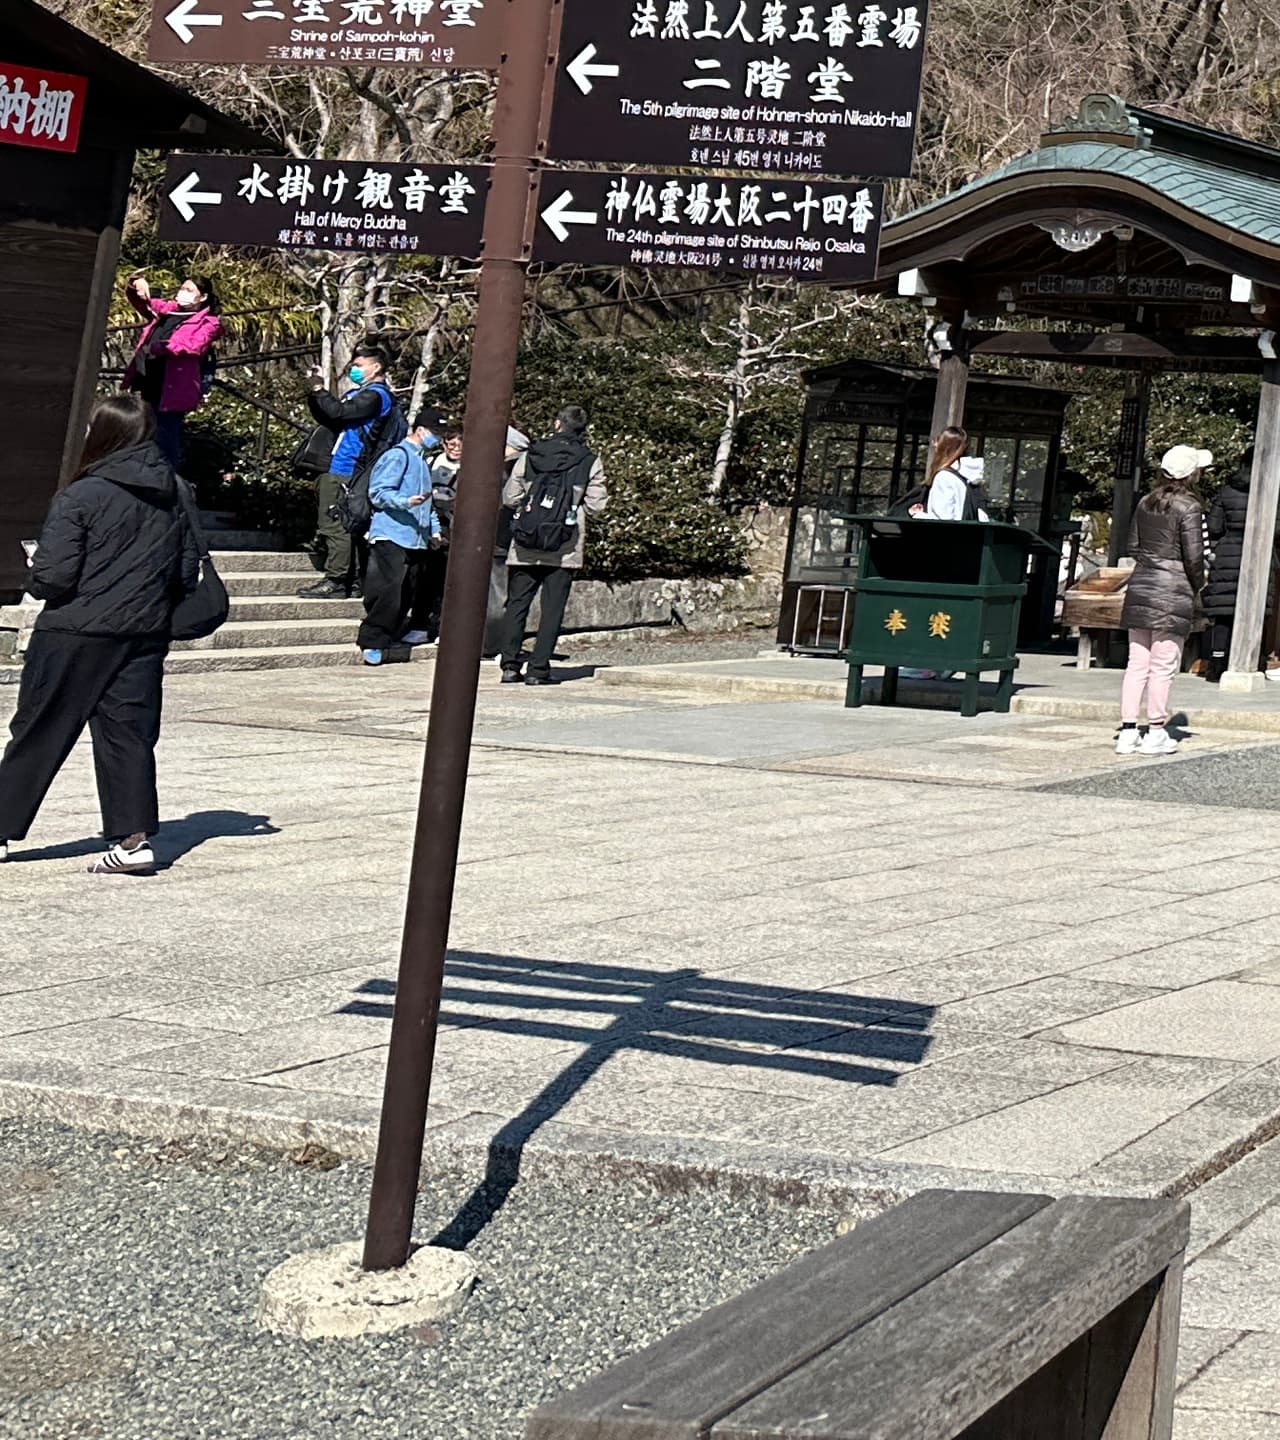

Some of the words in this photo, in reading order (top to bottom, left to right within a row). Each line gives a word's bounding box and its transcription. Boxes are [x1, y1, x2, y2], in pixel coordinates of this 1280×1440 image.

[289, 28, 329, 42] Shrine
[330, 29, 345, 42] of
[345, 29, 436, 44] Sampoh-kohjin
[682, 55, 854, 104] 二階堂
[619, 97, 641, 115] The
[642, 99, 663, 117] 5th
[663, 101, 719, 120] pilgrimage
[719, 104, 740, 120] site
[741, 105, 756, 121] of
[756, 106, 843, 124] Hohnen-shonin
[844, 108, 913, 128] Nikaido-hall
[236, 162, 477, 215] 水掛け観音堂
[293, 210, 316, 227] Hall
[316, 211, 330, 227] of
[330, 211, 362, 231] Mercy
[363, 212, 408, 231] Buddha
[604, 176, 875, 235] 神仏霊場大阪二十四番
[605, 227, 626, 243] The
[626, 228, 653, 245] 24th
[653, 230, 706, 248] pilgrimage
[706, 233, 726, 248] site
[726, 234, 740, 249] of
[740, 234, 793, 251] Shinbutsu
[824, 237, 867, 254] Osaka
